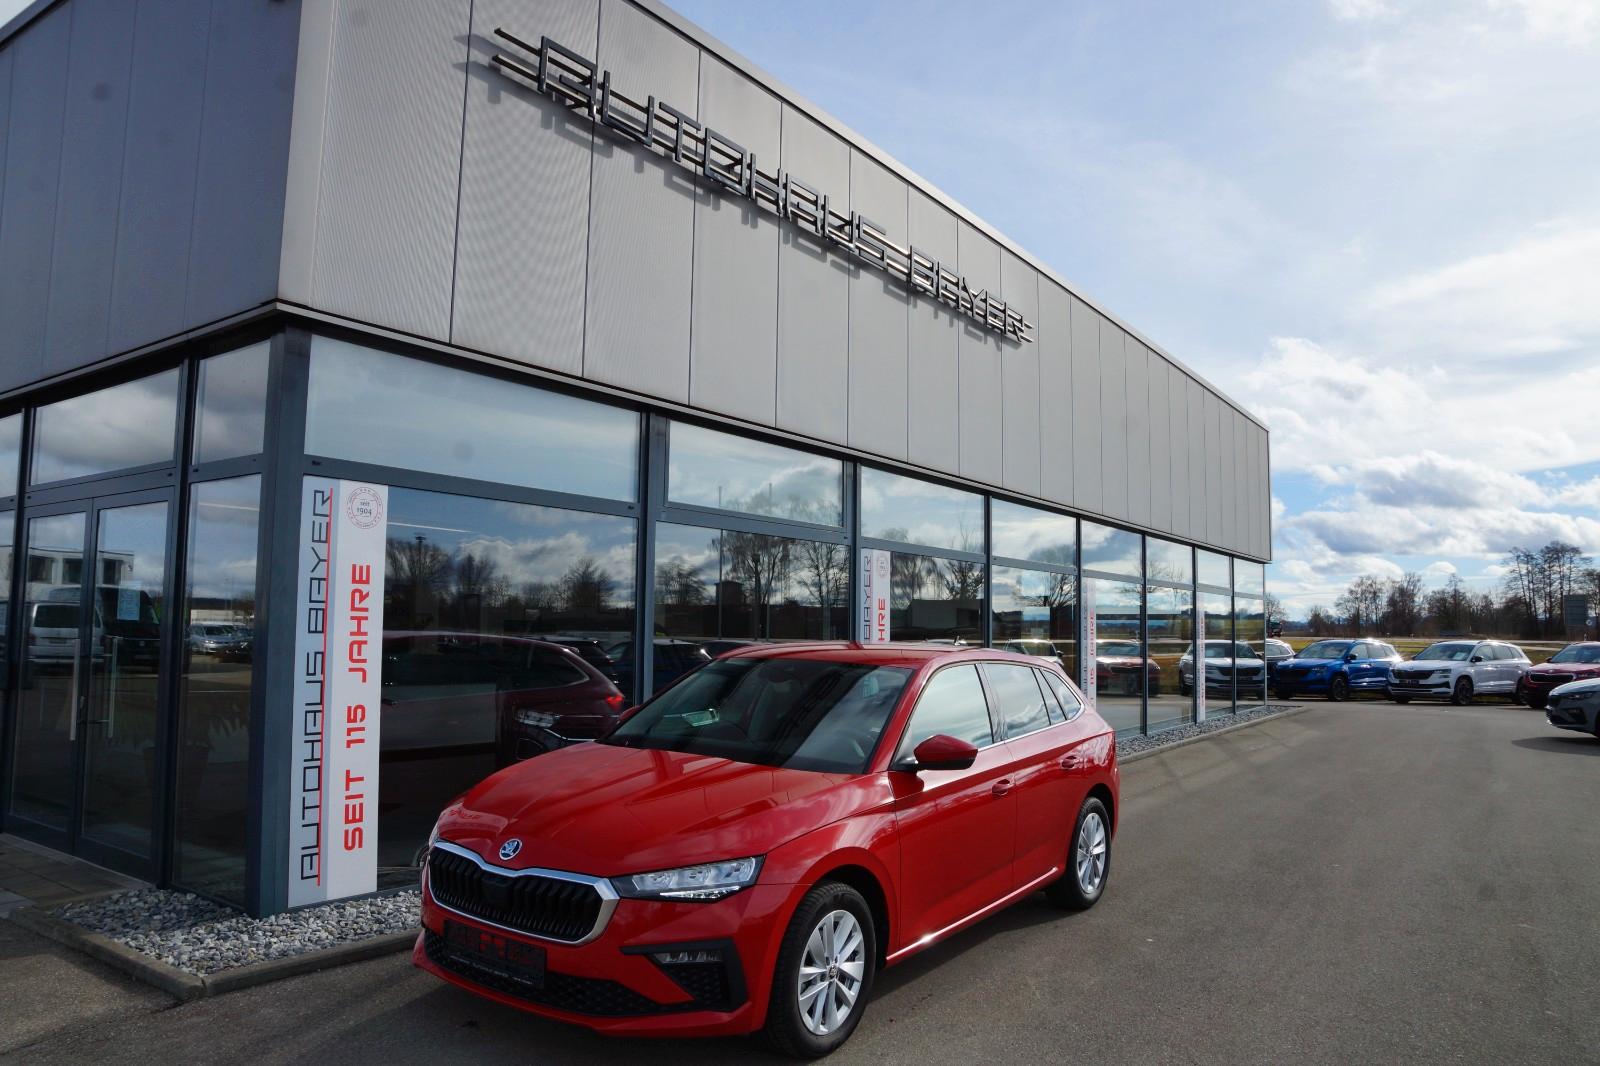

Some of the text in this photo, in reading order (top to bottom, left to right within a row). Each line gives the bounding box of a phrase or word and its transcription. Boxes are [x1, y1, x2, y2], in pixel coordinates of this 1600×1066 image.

[537, 35, 1025, 342] AUTOHAUS BAYER
[300, 489, 331, 880] AUTOHAUS BAYER
[344, 563, 371, 851] SEIT 115 JAHRE
[878, 598, 886, 641] HRE
